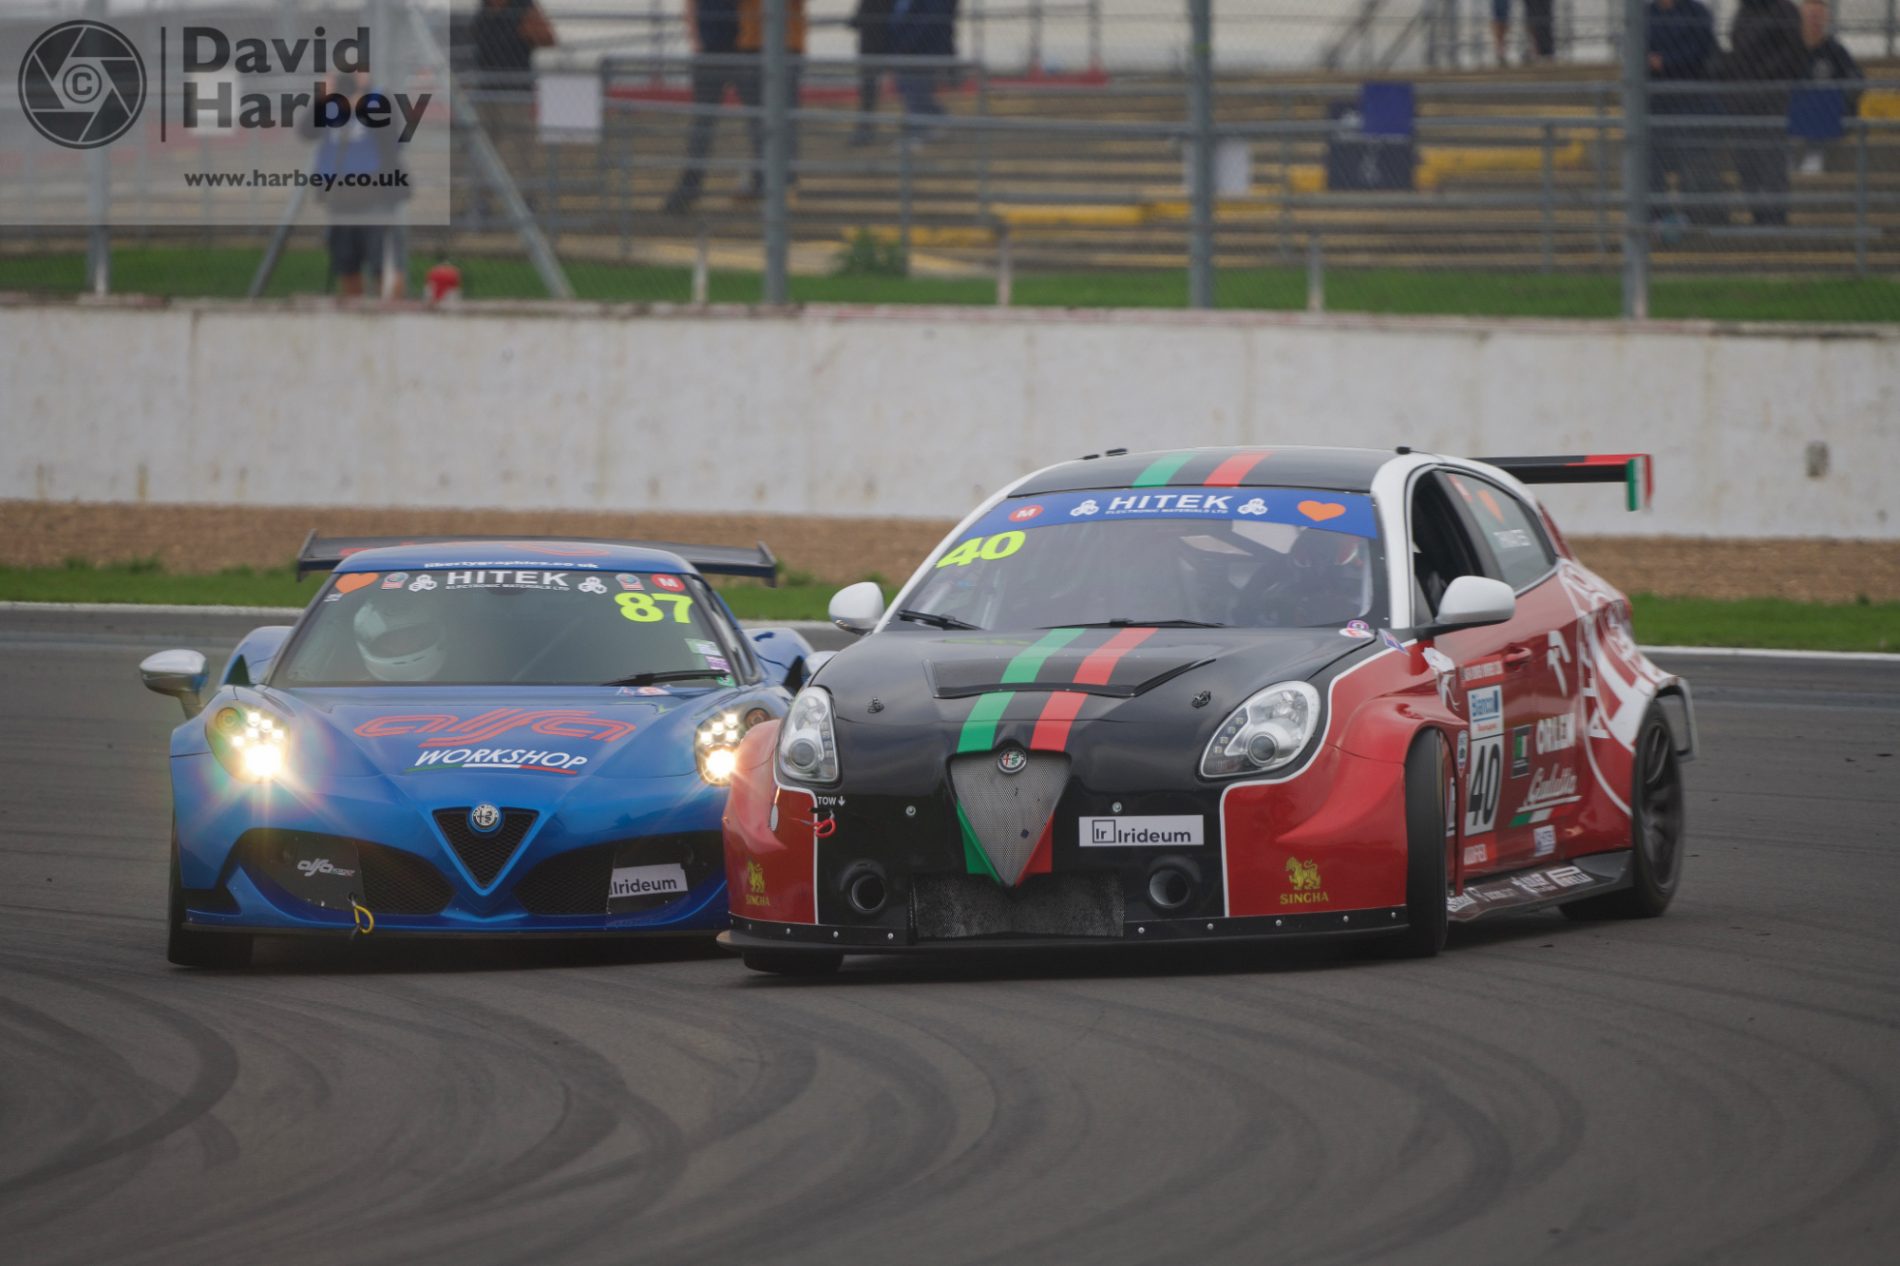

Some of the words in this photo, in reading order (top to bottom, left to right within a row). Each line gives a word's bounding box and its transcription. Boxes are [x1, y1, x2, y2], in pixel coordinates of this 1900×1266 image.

[1108, 495, 1233, 510] HITEK
[935, 530, 1026, 568] 40
[446, 571, 569, 587] HITEK
[614, 592, 693, 623] 87
[415, 749, 588, 770] WORKSHOP
[1469, 744, 1500, 826] 40
[817, 796, 837, 806] TOW
[1118, 828, 1192, 844] Irideum
[612, 876, 677, 895] Irideum
[1280, 891, 1329, 905] SINGHA
